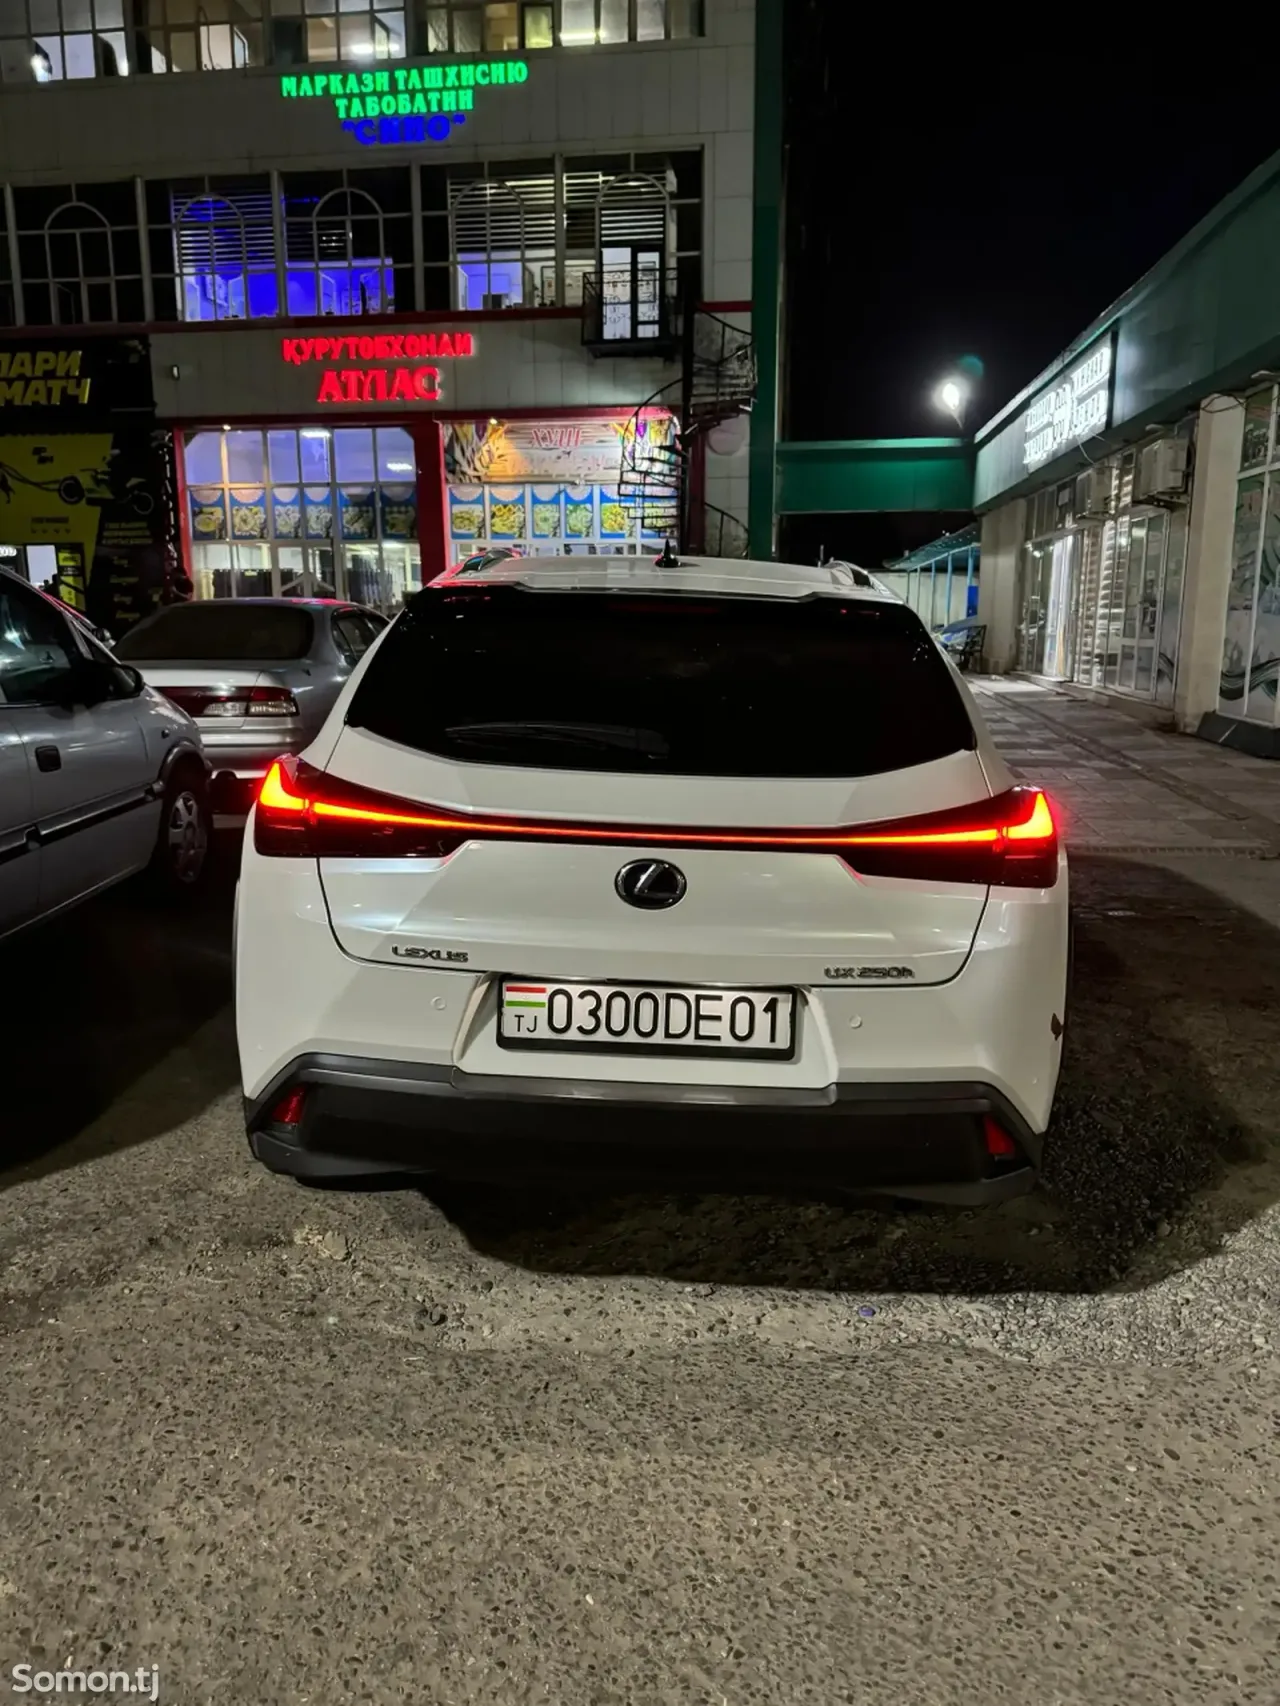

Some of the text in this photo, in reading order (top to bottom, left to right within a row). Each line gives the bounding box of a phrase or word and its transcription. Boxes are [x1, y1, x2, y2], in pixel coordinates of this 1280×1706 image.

[0, 378, 91, 406] МАТЧ
[391, 946, 469, 963] LEXUS
[823, 966, 915, 980] UX 250h
[514, 1014, 538, 1033] TJ
[547, 988, 780, 1043] 0300DE01
